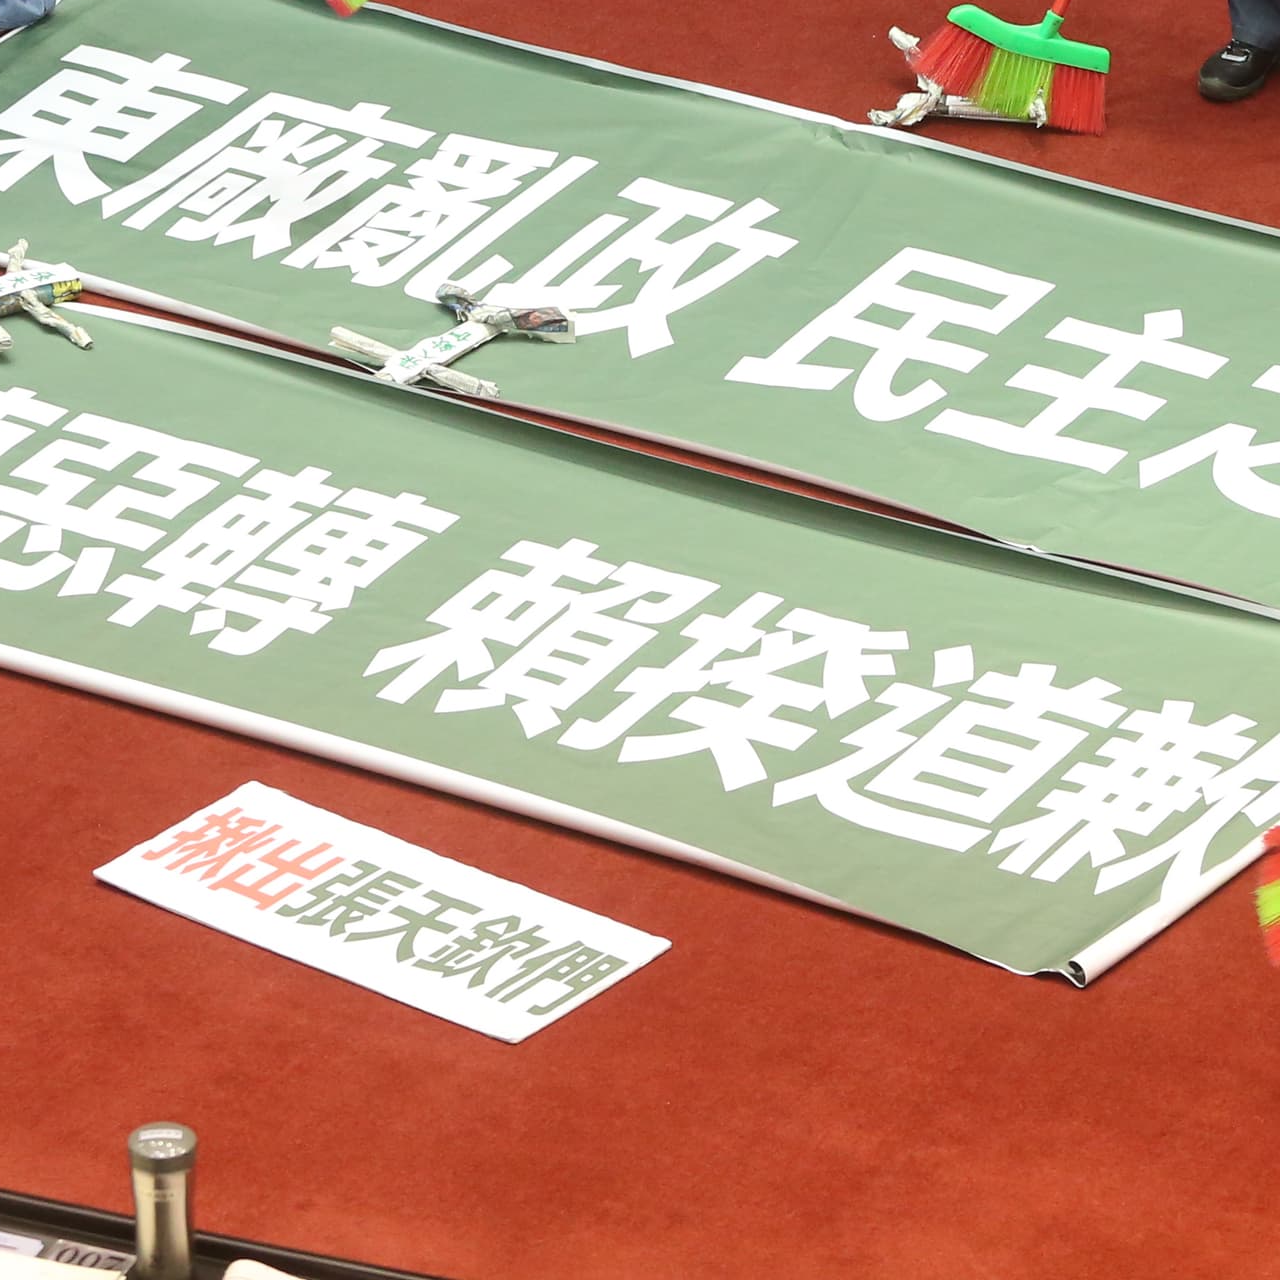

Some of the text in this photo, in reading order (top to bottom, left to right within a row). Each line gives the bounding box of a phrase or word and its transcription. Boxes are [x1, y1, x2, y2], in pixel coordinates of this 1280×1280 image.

[140, 807, 628, 1017] 揪出張天欽們
